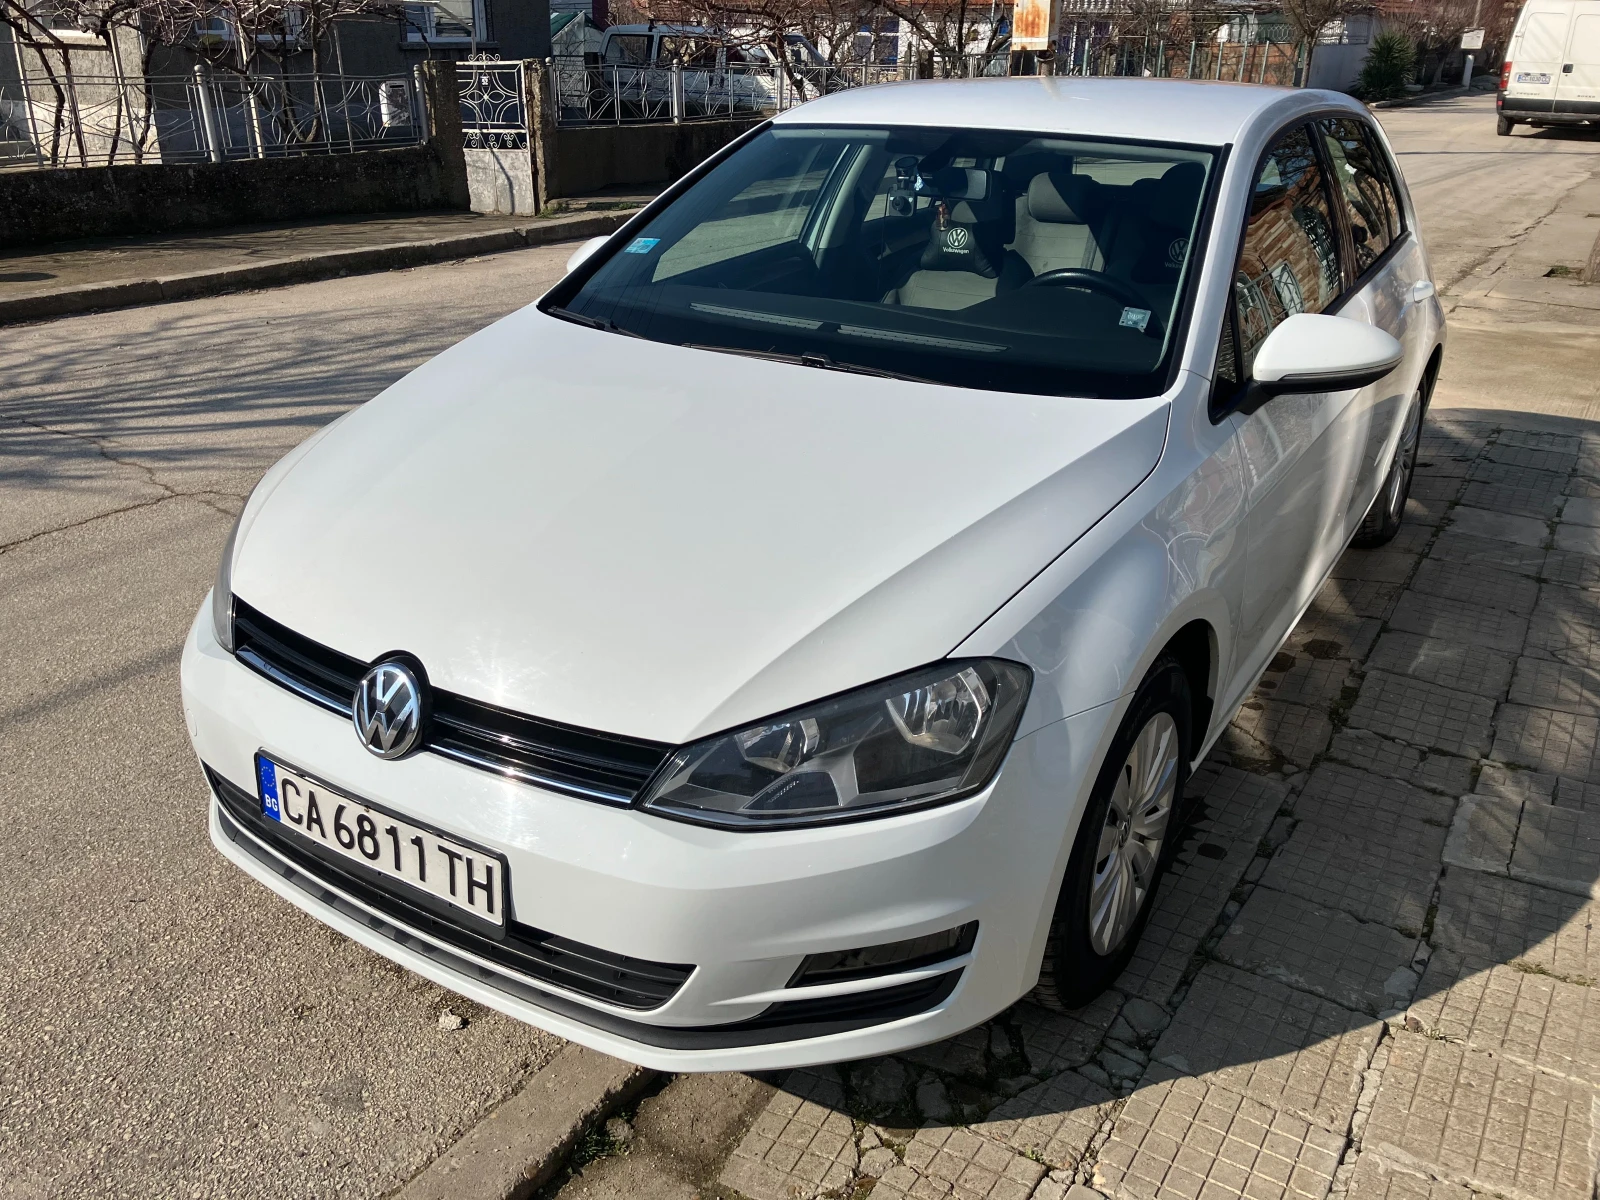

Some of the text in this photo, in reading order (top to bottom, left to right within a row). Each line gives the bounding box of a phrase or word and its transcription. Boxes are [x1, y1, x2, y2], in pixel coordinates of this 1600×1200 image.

[948, 228, 967, 247] VW
[357, 665, 417, 756] VW
[265, 793, 279, 812] BG
[281, 777, 495, 915] CA 6811 TH
